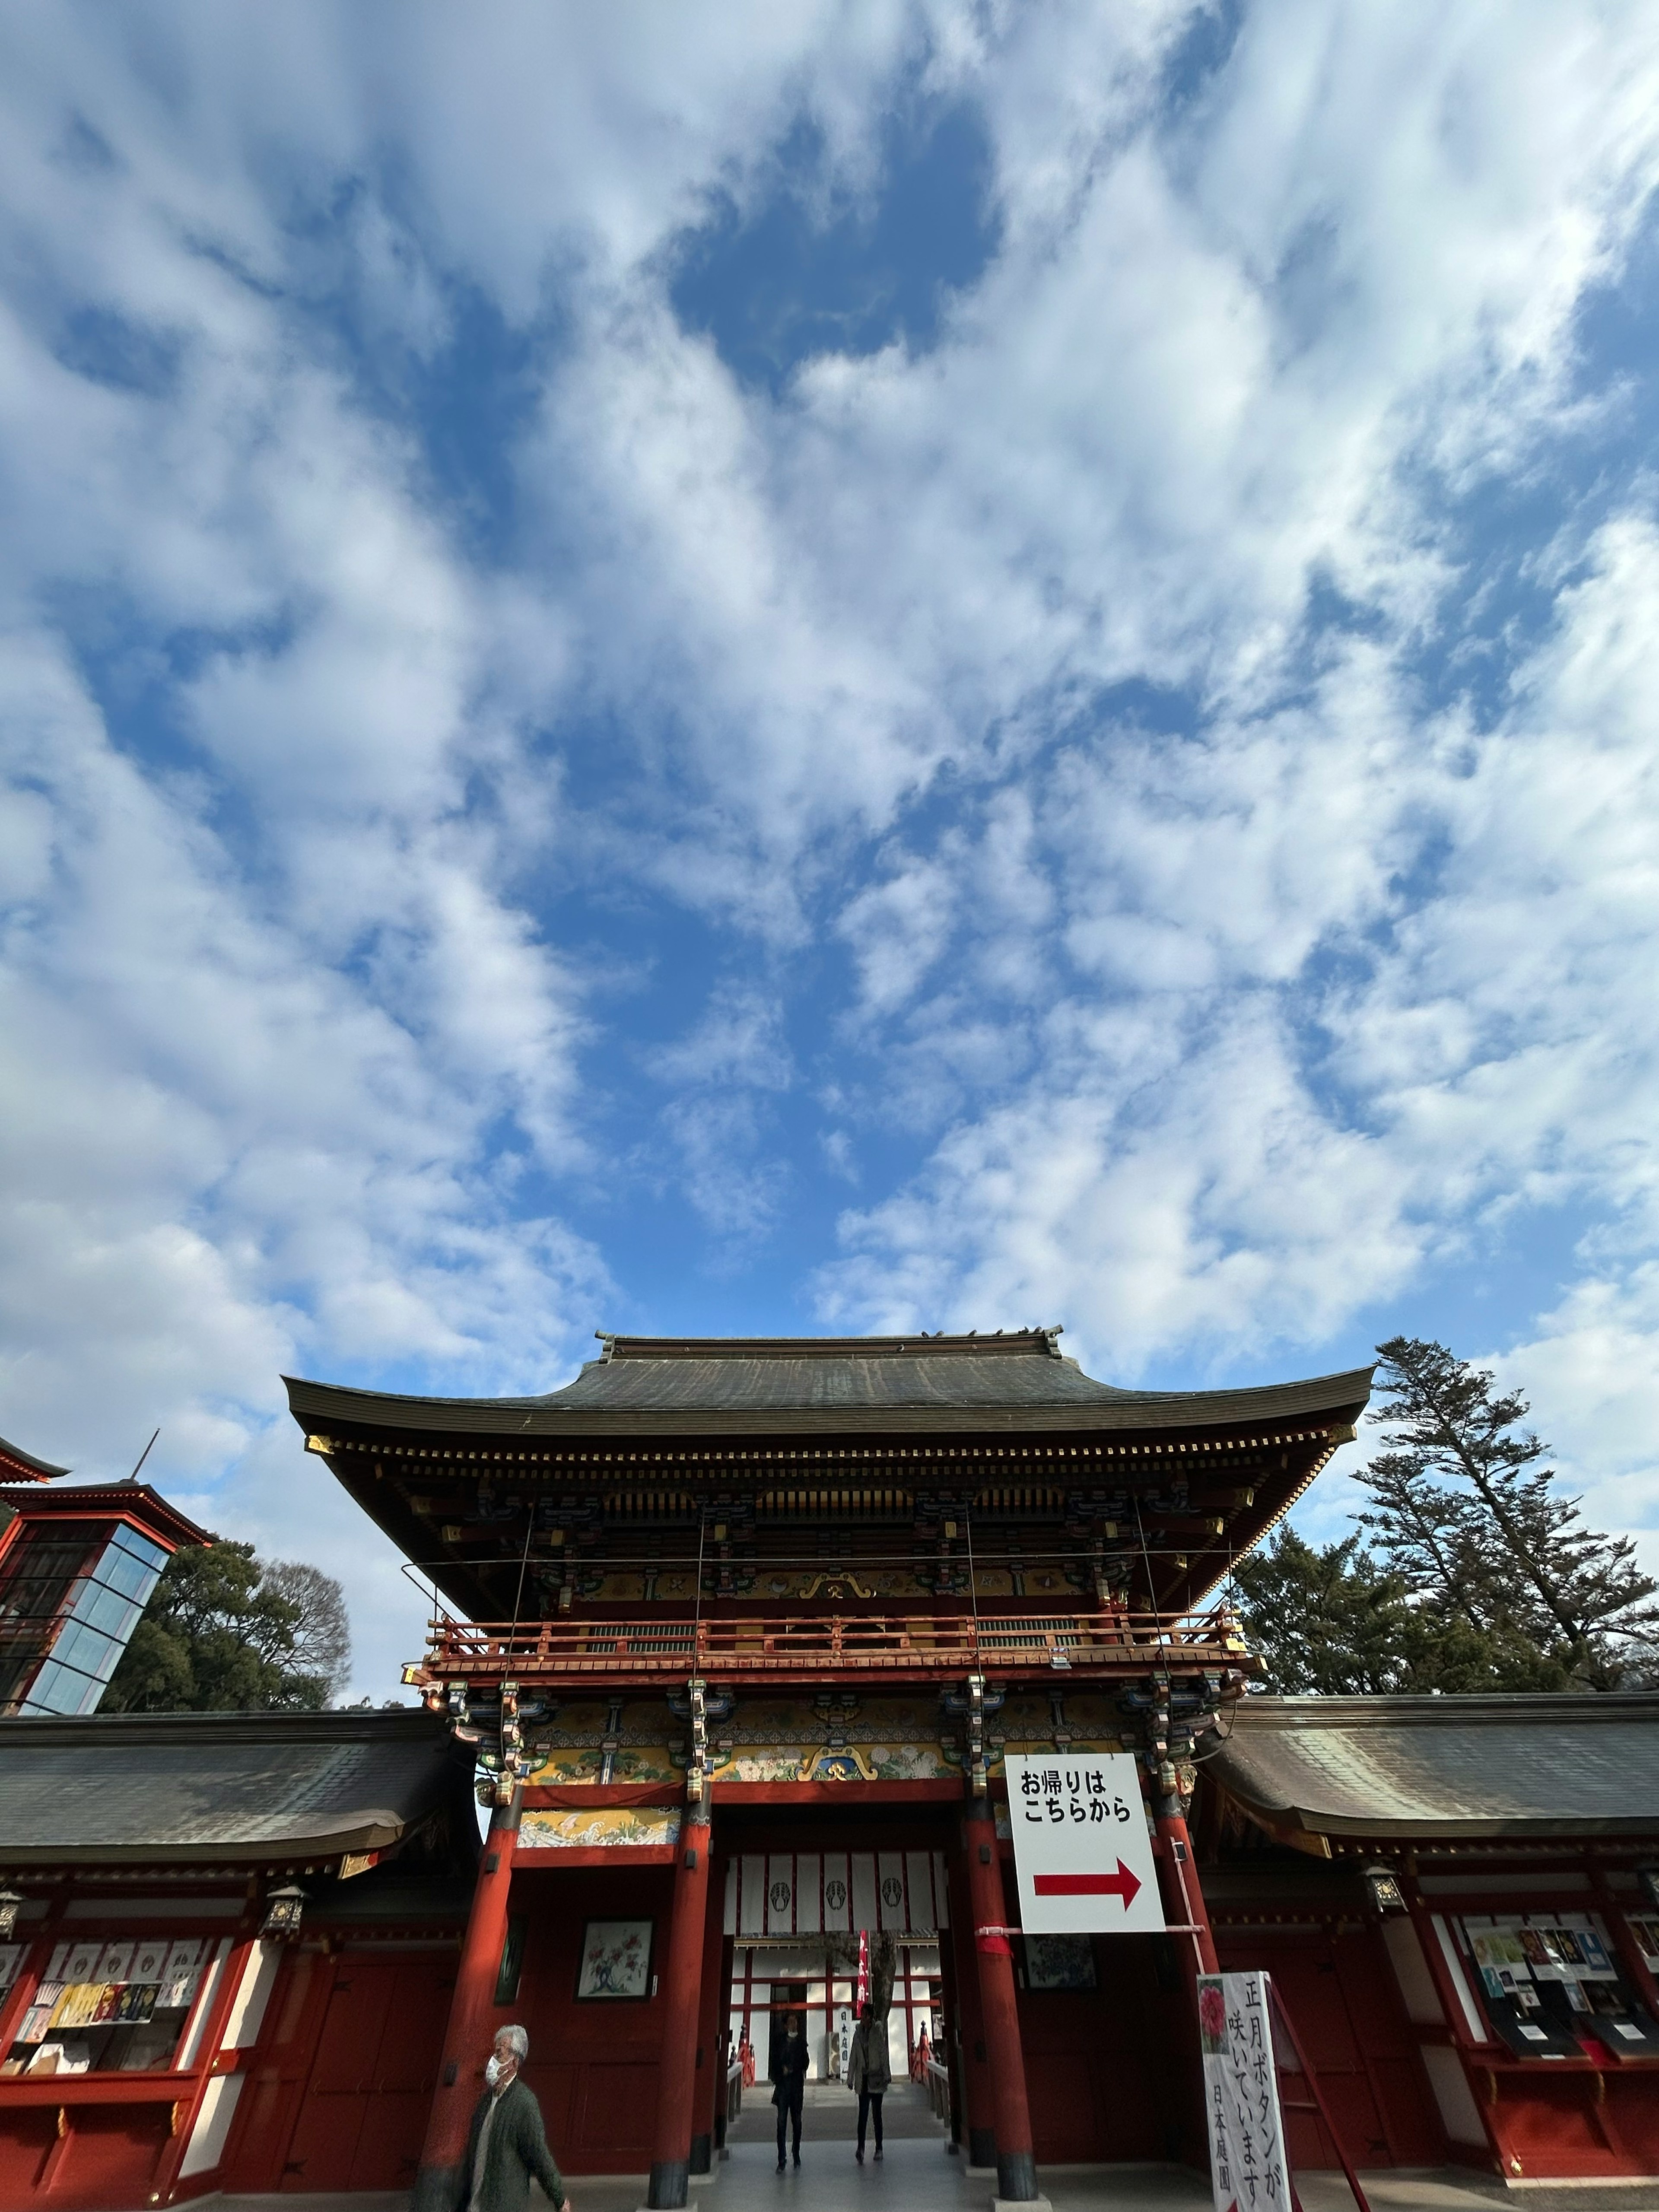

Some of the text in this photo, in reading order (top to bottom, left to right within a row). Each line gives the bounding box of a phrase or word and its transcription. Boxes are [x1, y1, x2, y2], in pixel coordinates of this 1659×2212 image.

[1021, 1770, 1106, 1796] お帰りは
[1025, 1796, 1130, 1823] こちらから
[1214, 2085, 1230, 2193] 日本庭園
[1228, 2010, 1259, 2207] 咲いています
[1246, 1980, 1281, 2200] 正月ボタンが
